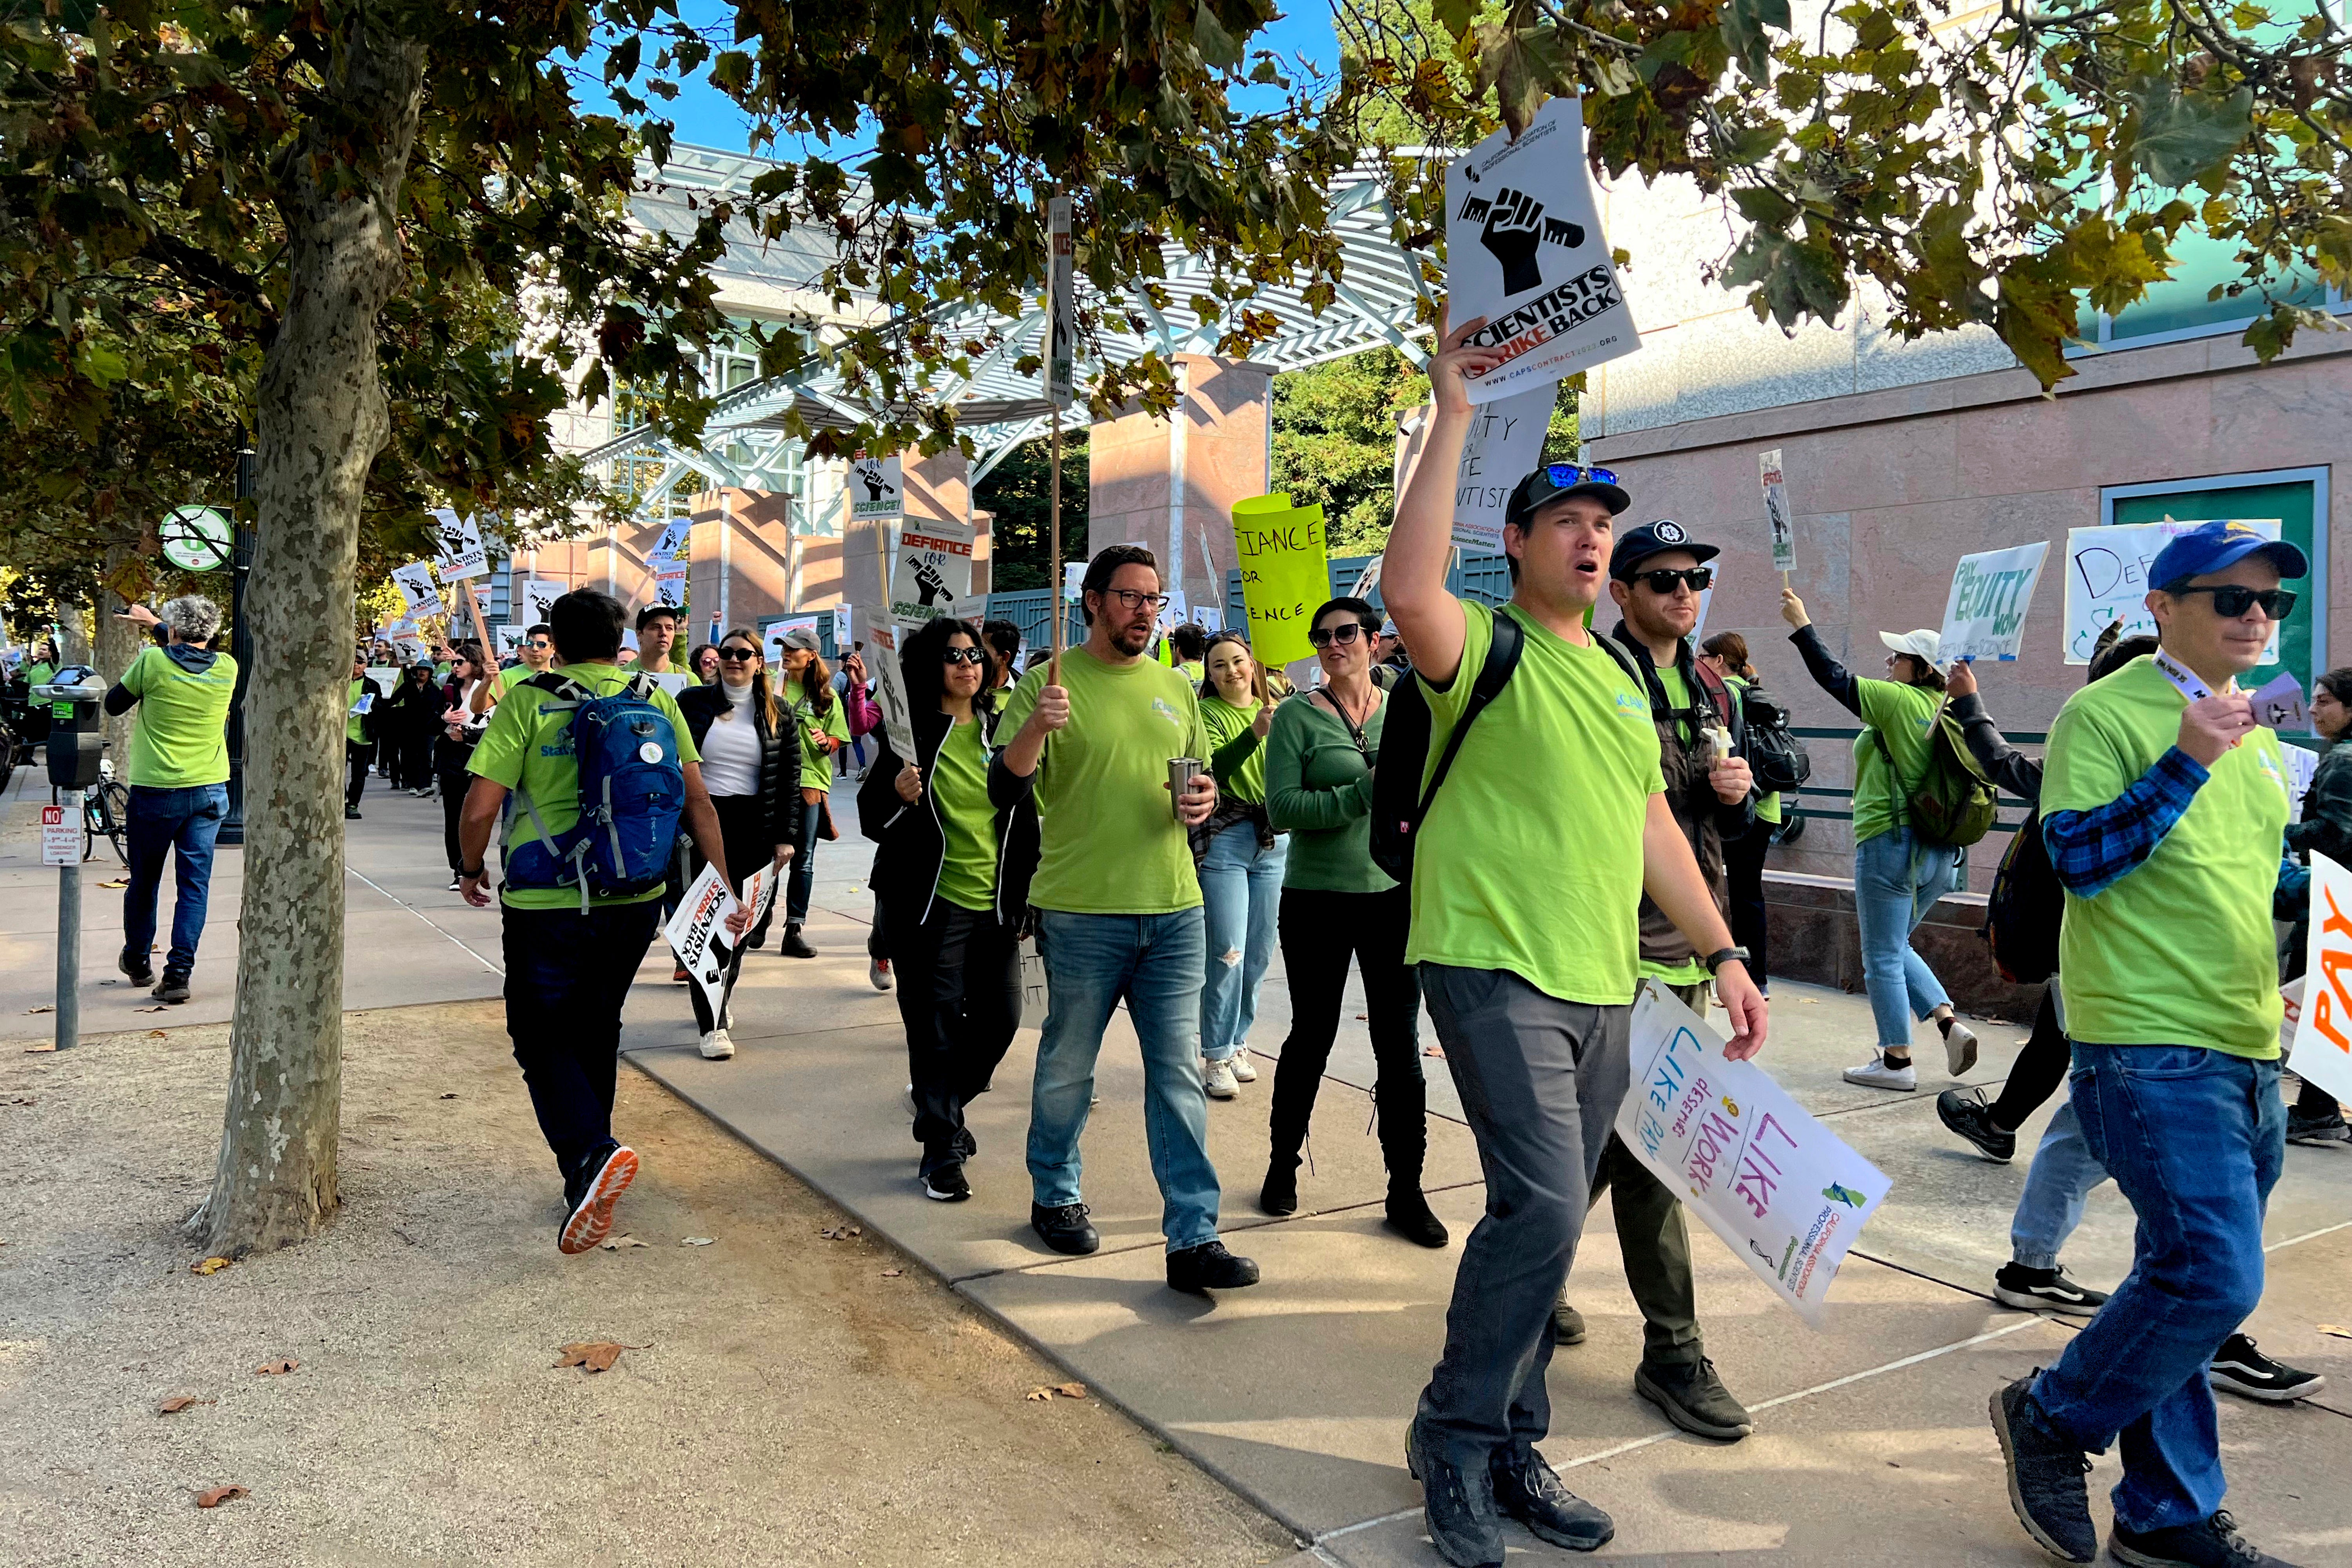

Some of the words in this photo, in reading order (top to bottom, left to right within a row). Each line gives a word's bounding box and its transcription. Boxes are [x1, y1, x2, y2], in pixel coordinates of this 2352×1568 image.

[1482, 146, 1510, 167] CALIFORNIA
[1511, 124, 1547, 147] SSOCIATION
[1547, 118, 1556, 129] OF
[1482, 145, 1521, 173] PROFESSIONAL
[1523, 125, 1557, 147] SCIENTISTS
[1470, 325, 1552, 376] SRIKE
[1548, 289, 1620, 334] BACK
[853, 499, 901, 513] SCIENCE!
[1455, 487, 1515, 508] NTIST
[1234, 521, 1321, 556] IANCE
[1465, 523, 1495, 532] ASSOCIATION
[1473, 530, 1499, 539] SCIENTISTS
[901, 532, 973, 556] DEFIANCE
[439, 550, 482, 570] SCINTISTS
[465, 555, 484, 567] BACK
[924, 552, 946, 566] FOR
[657, 571, 685, 581] DEFIANCE
[1240, 568, 1263, 583] OR
[1955, 561, 1979, 584] PAY
[1955, 568, 2033, 622] EQUITY
[891, 601, 946, 619] SCIENC
[1247, 603, 1305, 622] ENCE
[1992, 612, 2023, 635] NOW
[45, 810, 59, 823] NO
[694, 881, 719, 925] STRIKE
[688, 887, 726, 968] SCIENTISTS
[682, 922, 698, 960] BACK
[2314, 882, 2352, 1054] PAY
[1650, 1026, 1702, 1112] LIKE
[1688, 1112, 1739, 1192] WORK
[1735, 1112, 1798, 1218] LIKE
[1798, 1205, 1832, 1258] PROFESSIONAL
[1812, 1213, 1840, 1255] CALIFORNIA
